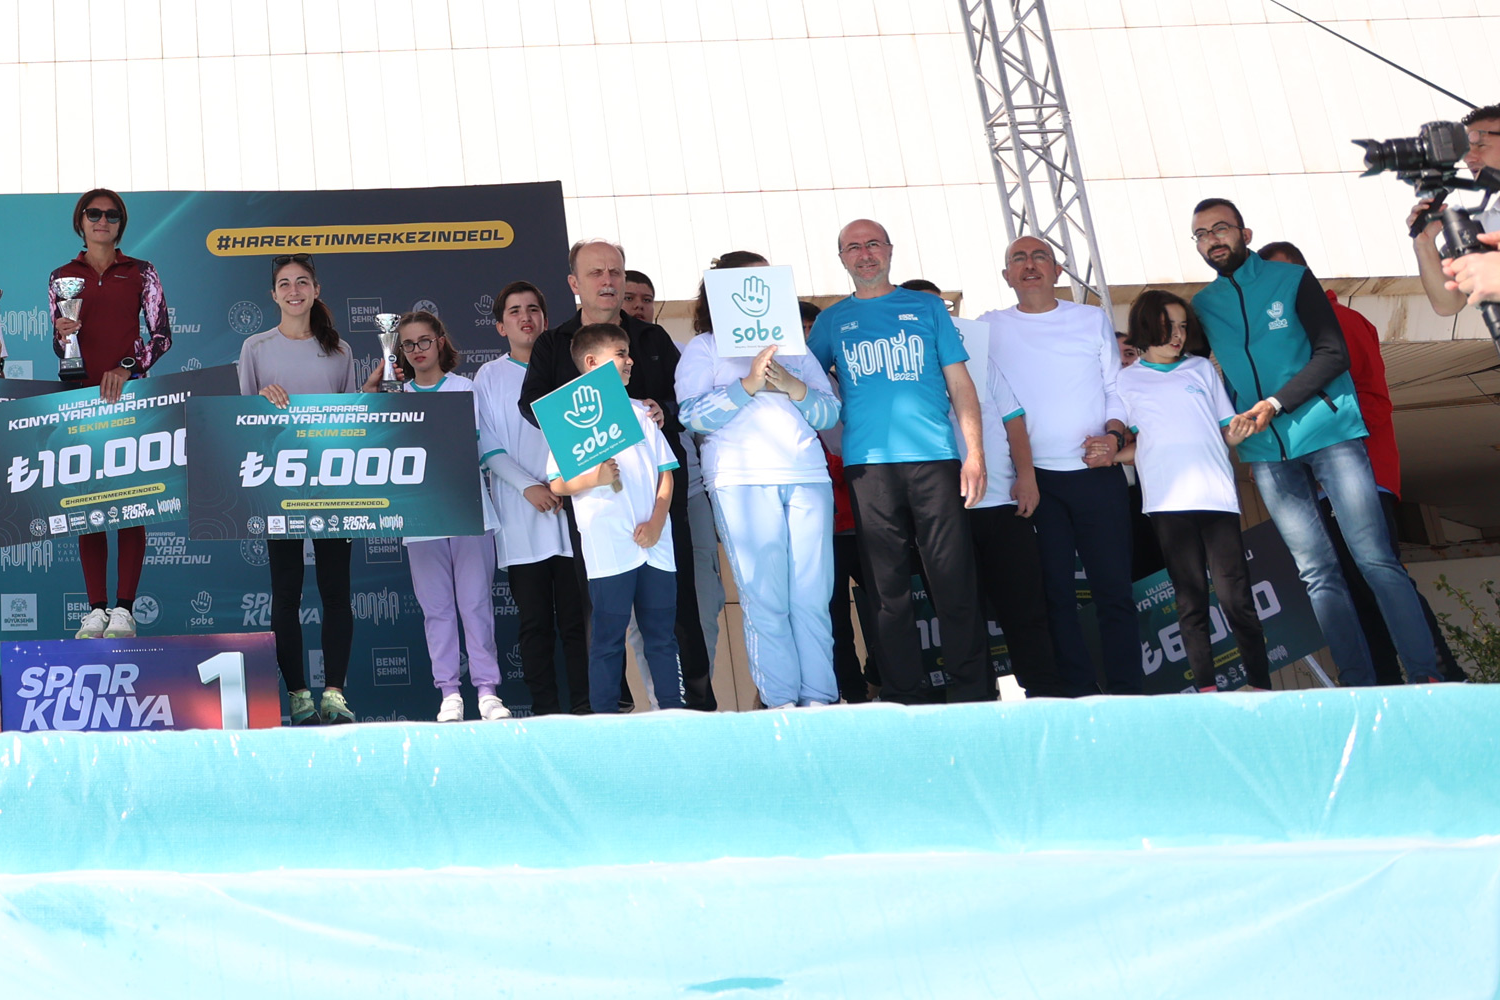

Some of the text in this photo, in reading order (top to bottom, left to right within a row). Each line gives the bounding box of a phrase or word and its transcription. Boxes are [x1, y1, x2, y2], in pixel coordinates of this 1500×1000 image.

[474, 316, 497, 326] sobe
[732, 319, 784, 344] sobe
[288, 405, 368, 413] ULUSLARARASI
[8, 413, 60, 431] KONYA
[60, 406, 96, 422] YARI
[236, 412, 425, 425] KONYA YARI MARATONU
[67, 416, 136, 435] 15 EKİM 2023
[296, 429, 366, 438] 15 EKİM 2023
[572, 423, 622, 462] sobe
[121, 502, 148, 513] SPOR
[342, 516, 370, 524] SPOR
[343, 522, 377, 530] KONYA
[155, 546, 187, 554] YARI
[143, 555, 211, 564] ARATONU
[190, 616, 214, 625] sobe
[16, 664, 139, 699] SPOR
[197, 651, 248, 730] 1
[21, 688, 175, 731] KONYA
